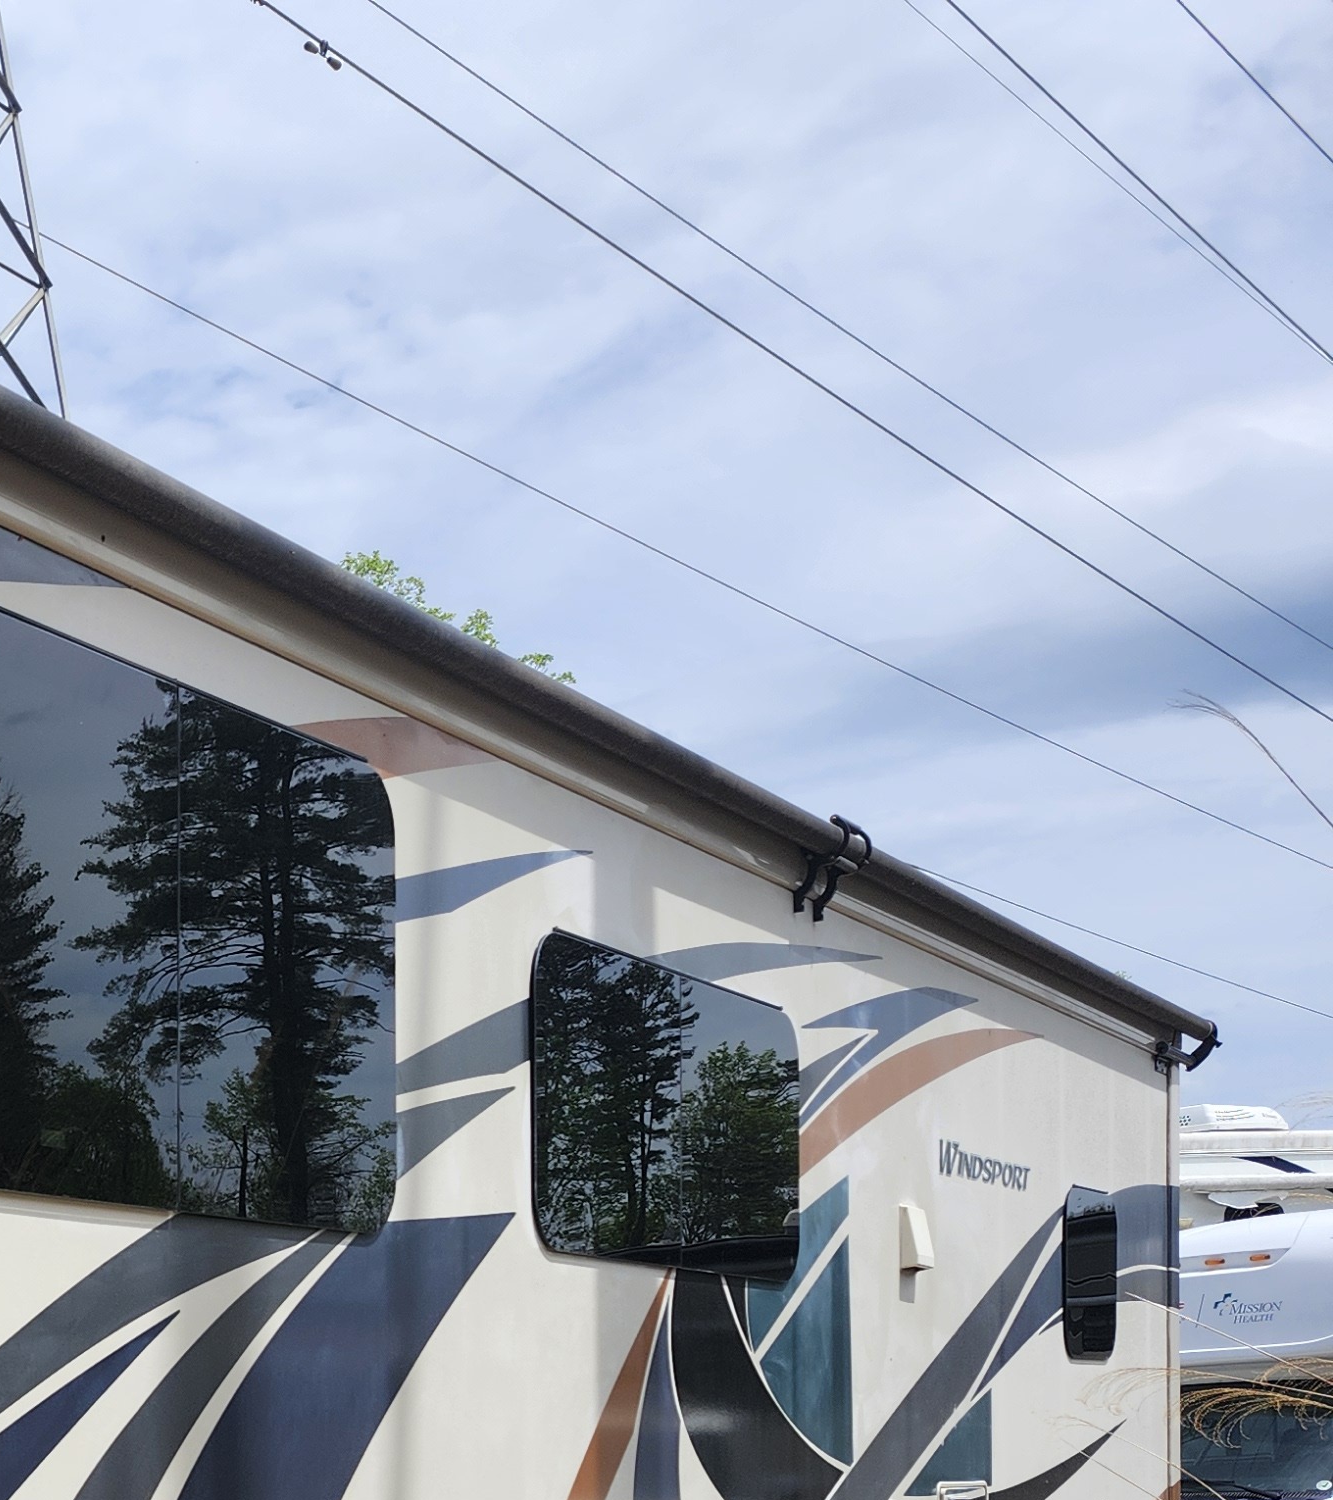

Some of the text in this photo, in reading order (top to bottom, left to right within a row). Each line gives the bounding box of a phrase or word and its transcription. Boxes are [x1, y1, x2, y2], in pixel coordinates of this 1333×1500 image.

[939, 1139, 1030, 1191] WINDSPORT
[1229, 1301, 1282, 1315] MISSION
[1233, 1313, 1273, 1324] HEALTH
